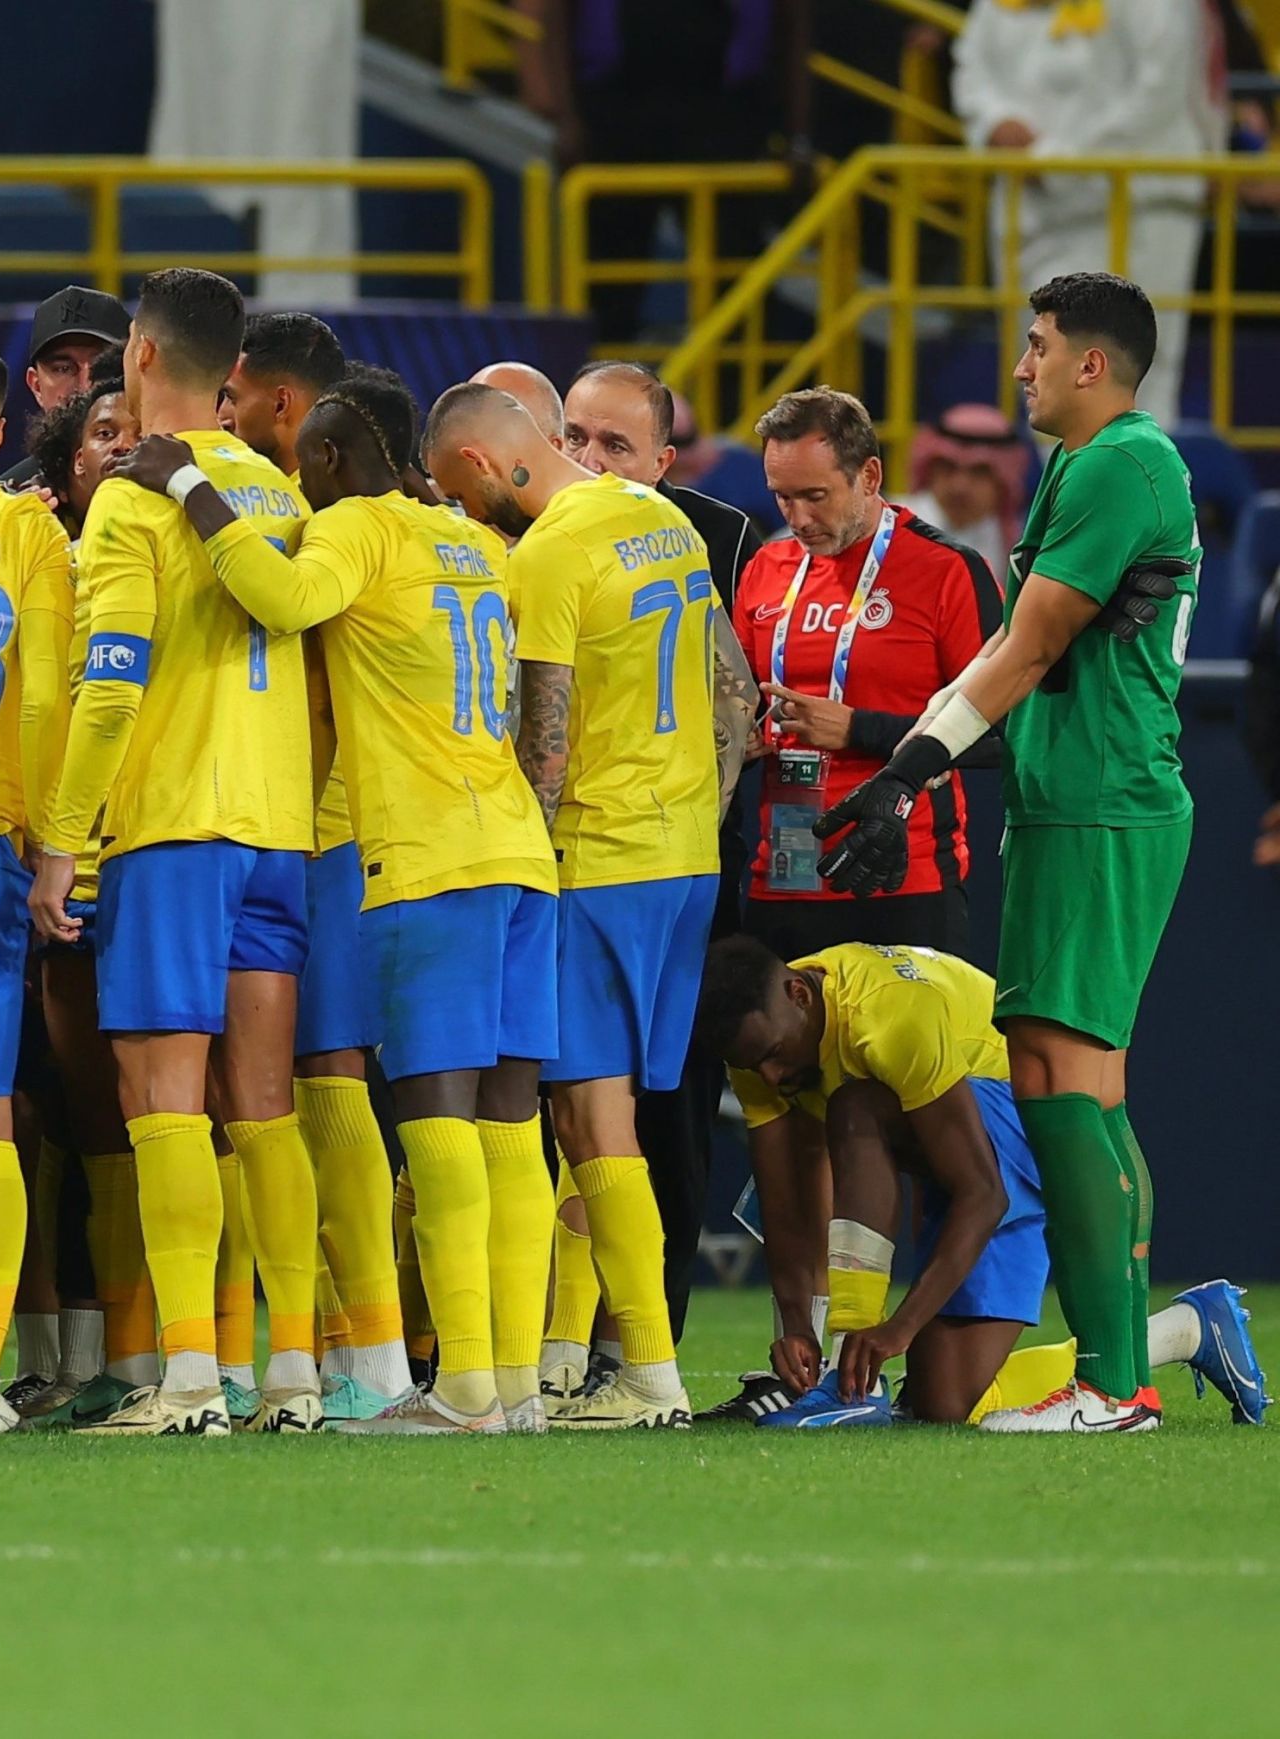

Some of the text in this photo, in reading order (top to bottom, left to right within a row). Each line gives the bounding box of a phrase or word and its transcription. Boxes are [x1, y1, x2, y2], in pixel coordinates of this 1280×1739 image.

[801, 602, 843, 633] DC
[85, 644, 135, 671] AFC
[432, 585, 512, 743] 10
